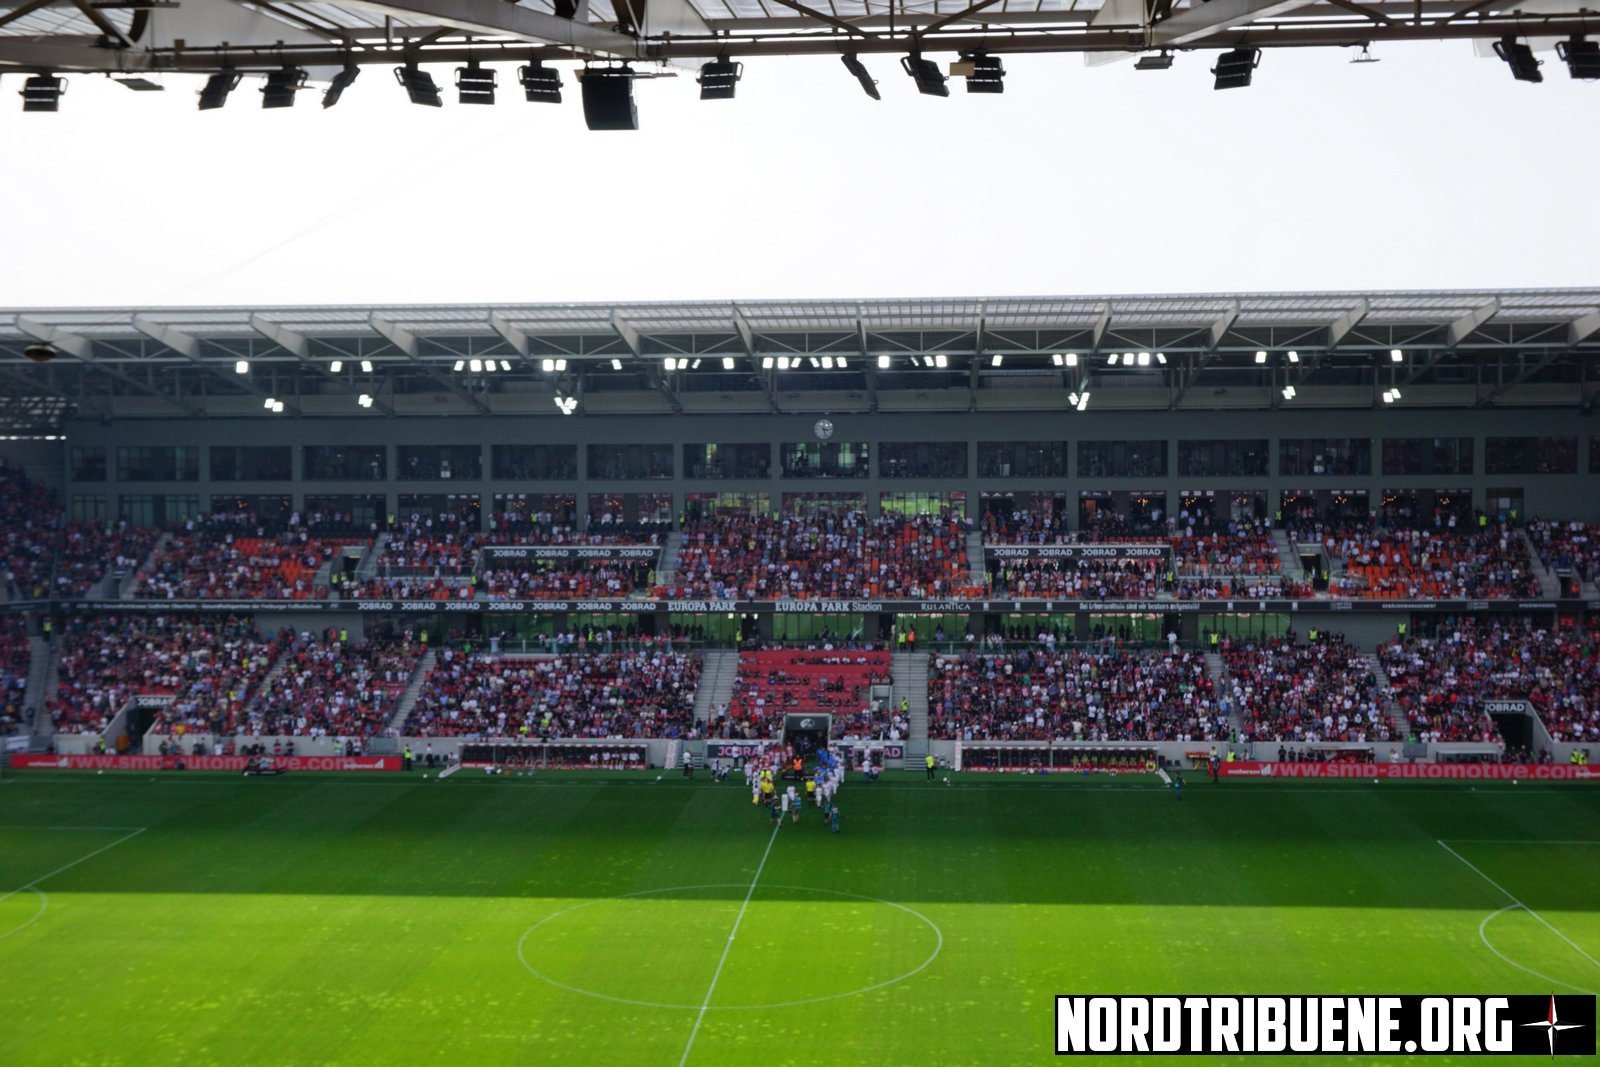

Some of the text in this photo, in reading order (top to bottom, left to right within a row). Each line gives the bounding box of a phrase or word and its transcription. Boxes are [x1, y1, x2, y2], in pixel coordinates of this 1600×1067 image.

[493, 549, 653, 557] JOBRAD JOBRAD JOBRAD JOBRAD
[994, 548, 1161, 556] JOBRAD JOBRAD JOBRAD JOBRAD
[358, 602, 656, 610] JOBRAD JOBRAD JOBRAD JOBRAD JOBRAD JOBRAD JOBRAD
[667, 602, 737, 611] EUROPA PARK
[775, 602, 883, 611] EUROPA PARK Stadion
[921, 602, 971, 611] RULANTICA
